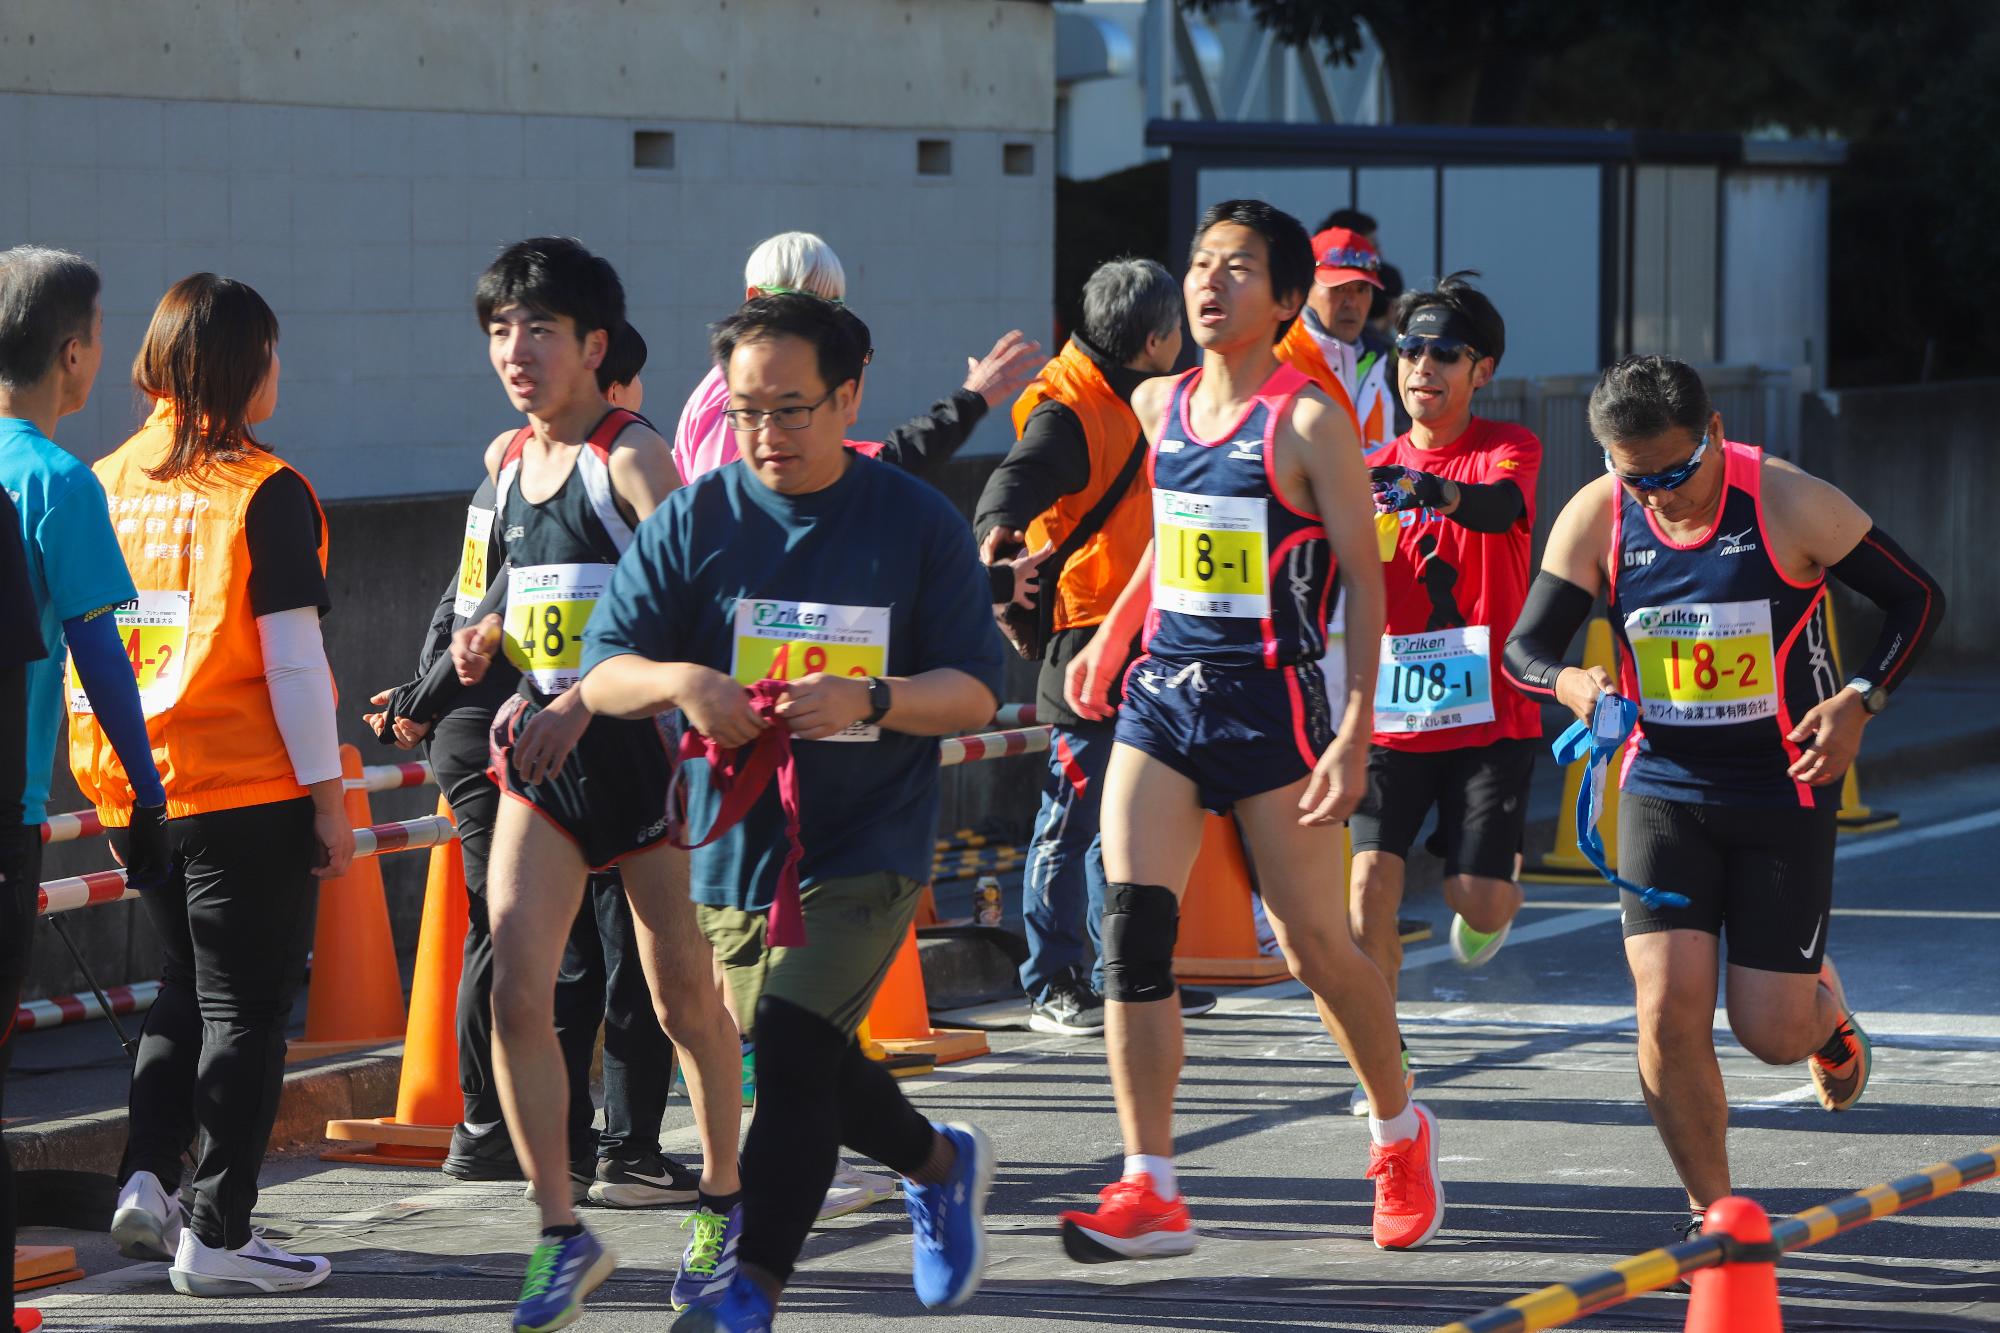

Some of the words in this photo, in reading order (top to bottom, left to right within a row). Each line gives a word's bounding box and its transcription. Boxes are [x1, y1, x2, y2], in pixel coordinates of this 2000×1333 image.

[1180, 529, 1248, 583] 18-1
[1624, 550, 1656, 567] DNP
[1392, 662, 1472, 703] 108-1
[1671, 640, 1758, 690] 18-2
